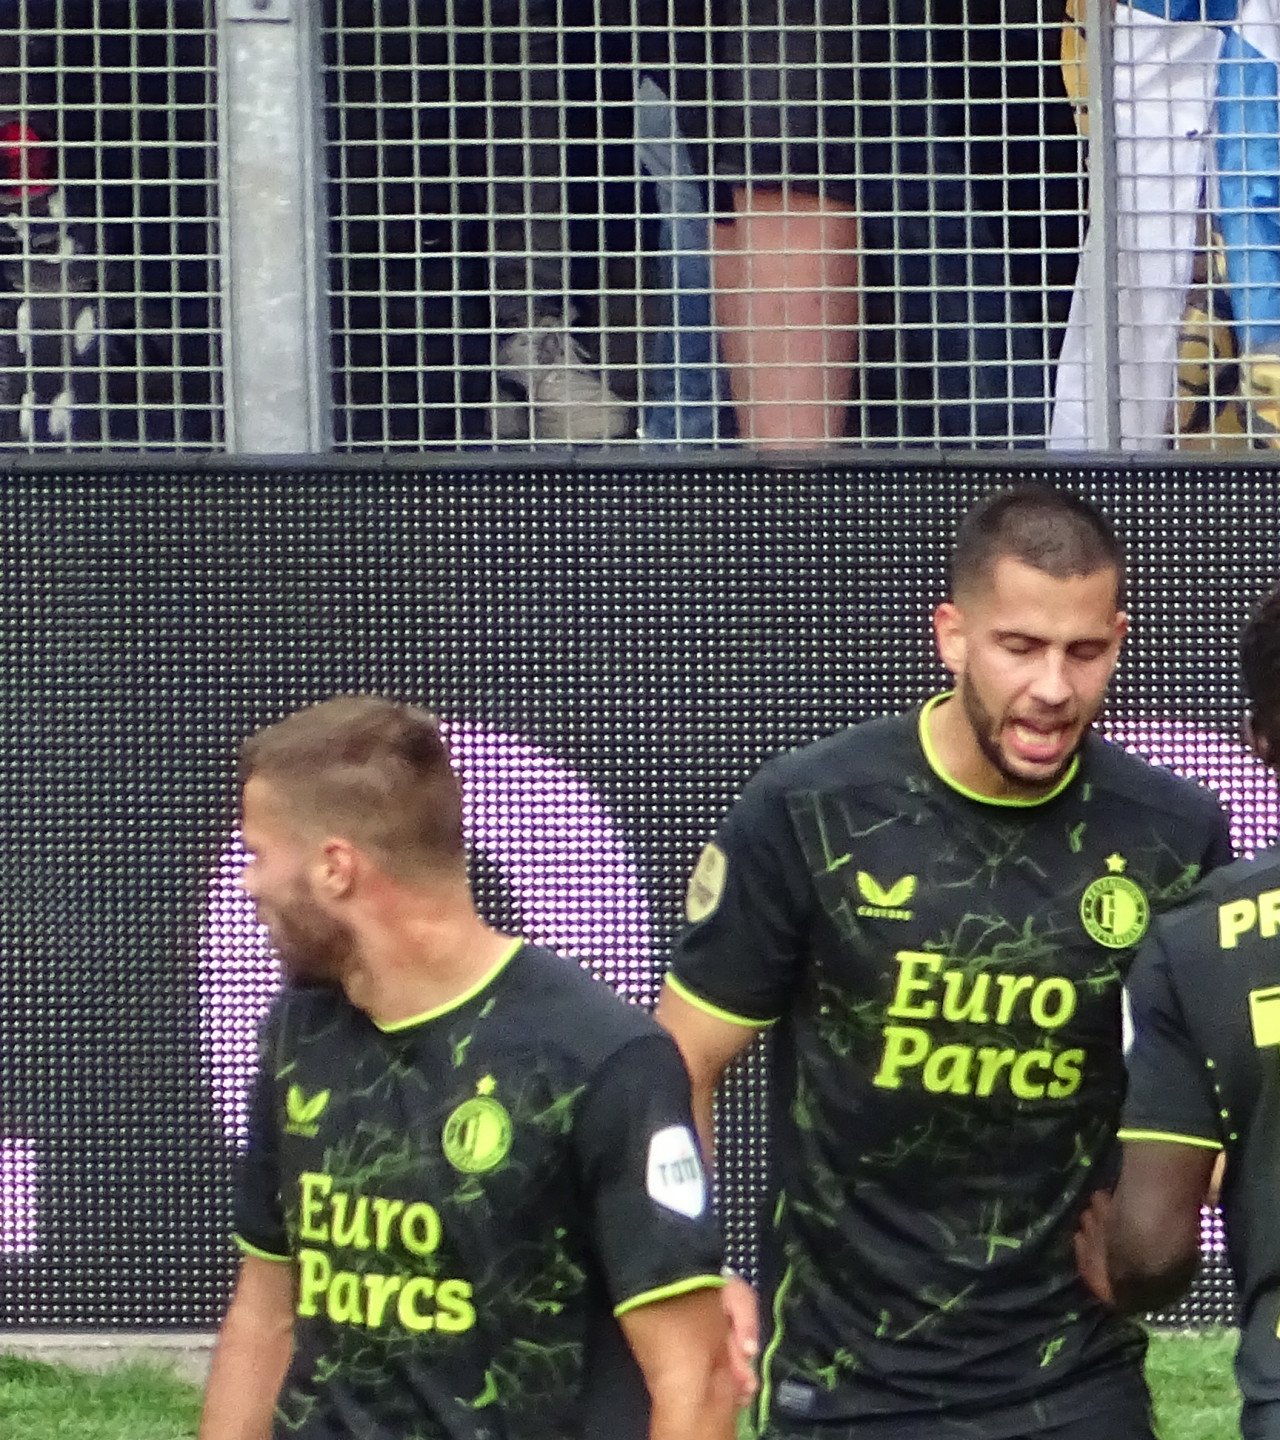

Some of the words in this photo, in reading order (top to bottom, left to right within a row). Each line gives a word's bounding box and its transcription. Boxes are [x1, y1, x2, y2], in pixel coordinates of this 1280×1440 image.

[886, 951, 1077, 1029] Euro
[872, 1025, 1087, 1099] Parcs
[298, 1172, 442, 1256] Euro
[296, 1249, 476, 1333] Parcs
